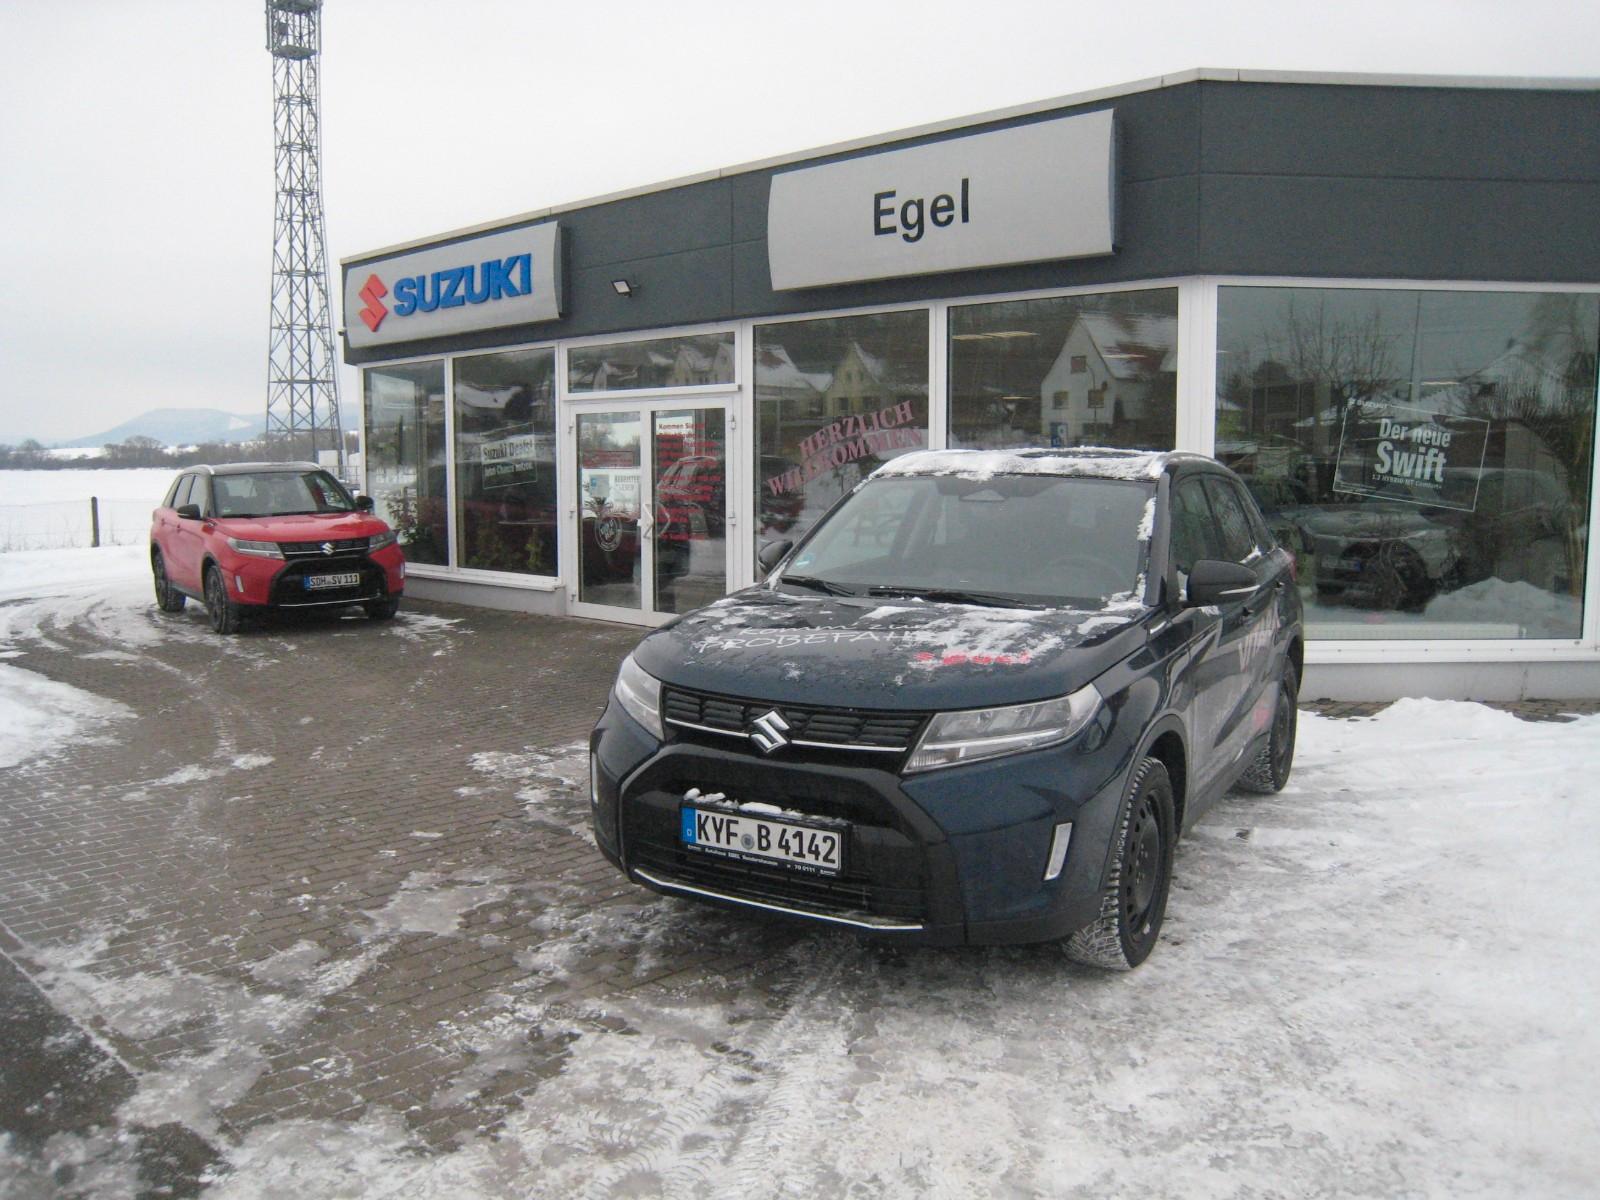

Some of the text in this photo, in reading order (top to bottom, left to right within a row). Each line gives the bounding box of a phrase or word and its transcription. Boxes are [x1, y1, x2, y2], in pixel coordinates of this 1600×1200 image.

[874, 178, 969, 243] Egel
[393, 253, 532, 317] SUZUKI
[799, 400, 914, 458] HERZLICH
[1379, 418, 1450, 448] Der neue
[767, 425, 922, 497] WILLKOMMEN
[1374, 441, 1447, 483] Swift
[332, 575, 342, 585] SV
[697, 813, 837, 865] KYF B 4142
